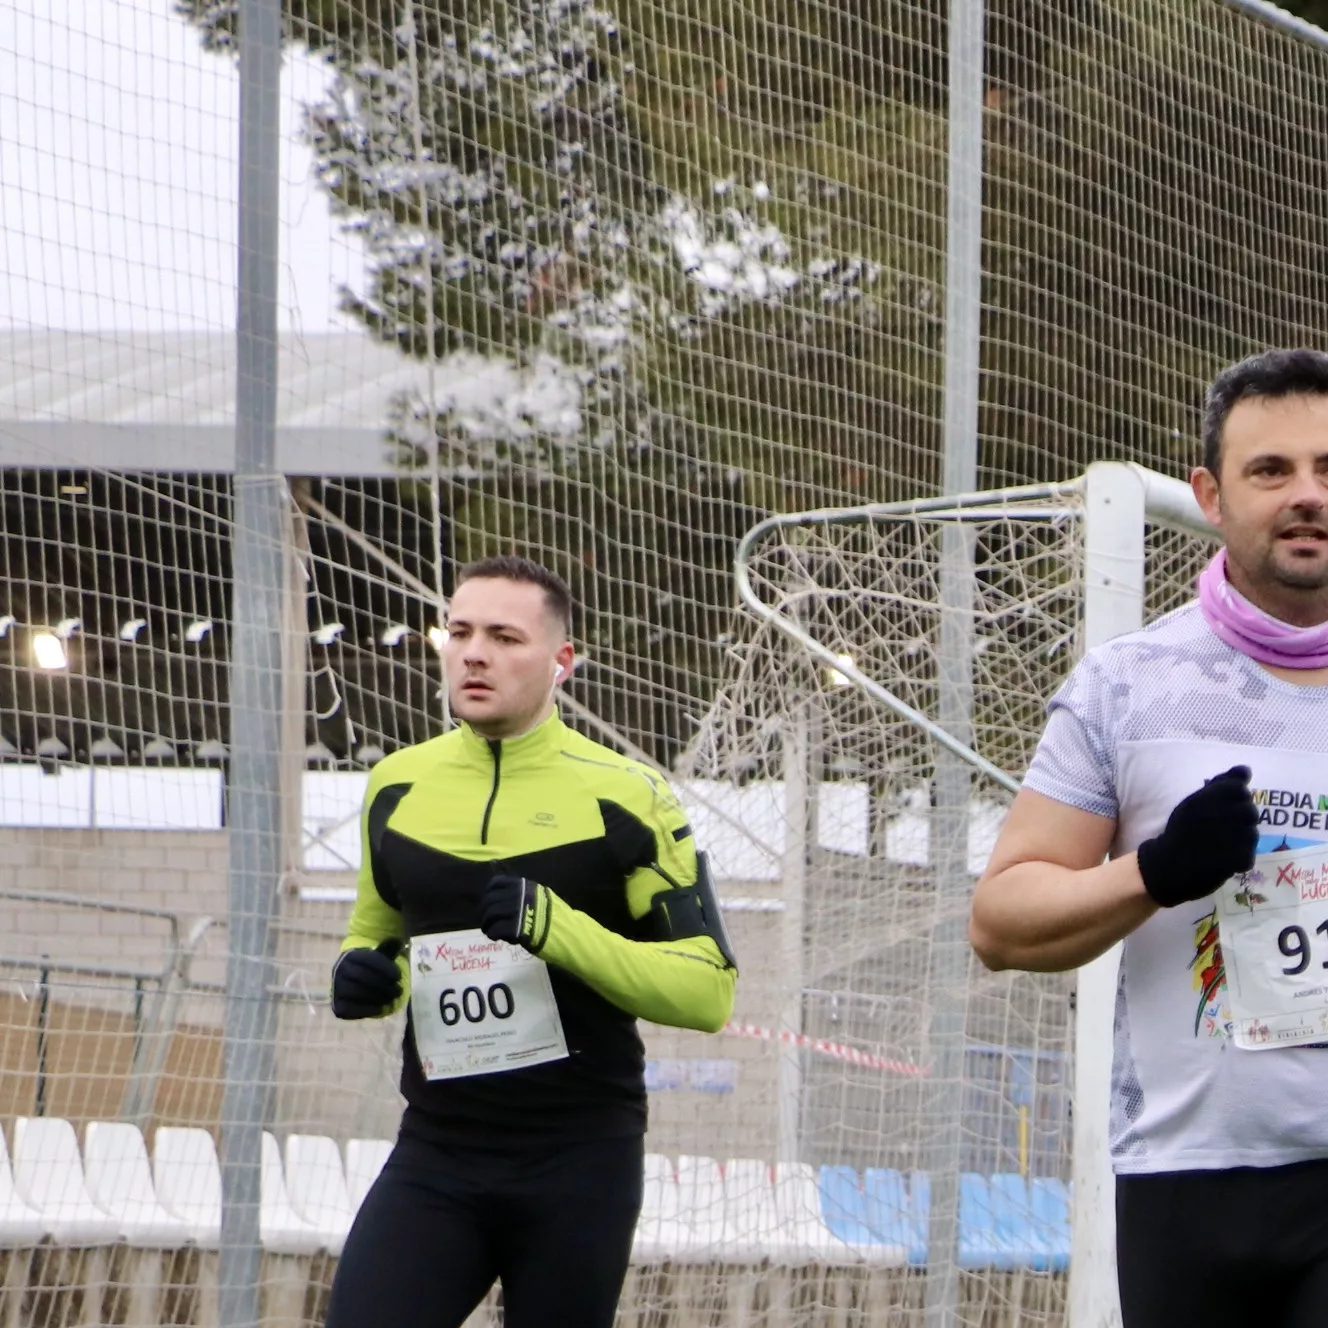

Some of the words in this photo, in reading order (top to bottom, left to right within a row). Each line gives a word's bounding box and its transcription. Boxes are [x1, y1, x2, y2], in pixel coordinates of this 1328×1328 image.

[1250, 788, 1314, 811] MEDIA
[1292, 810, 1322, 830] DE
[1275, 861, 1296, 888] X
[438, 982, 516, 1027] 600
